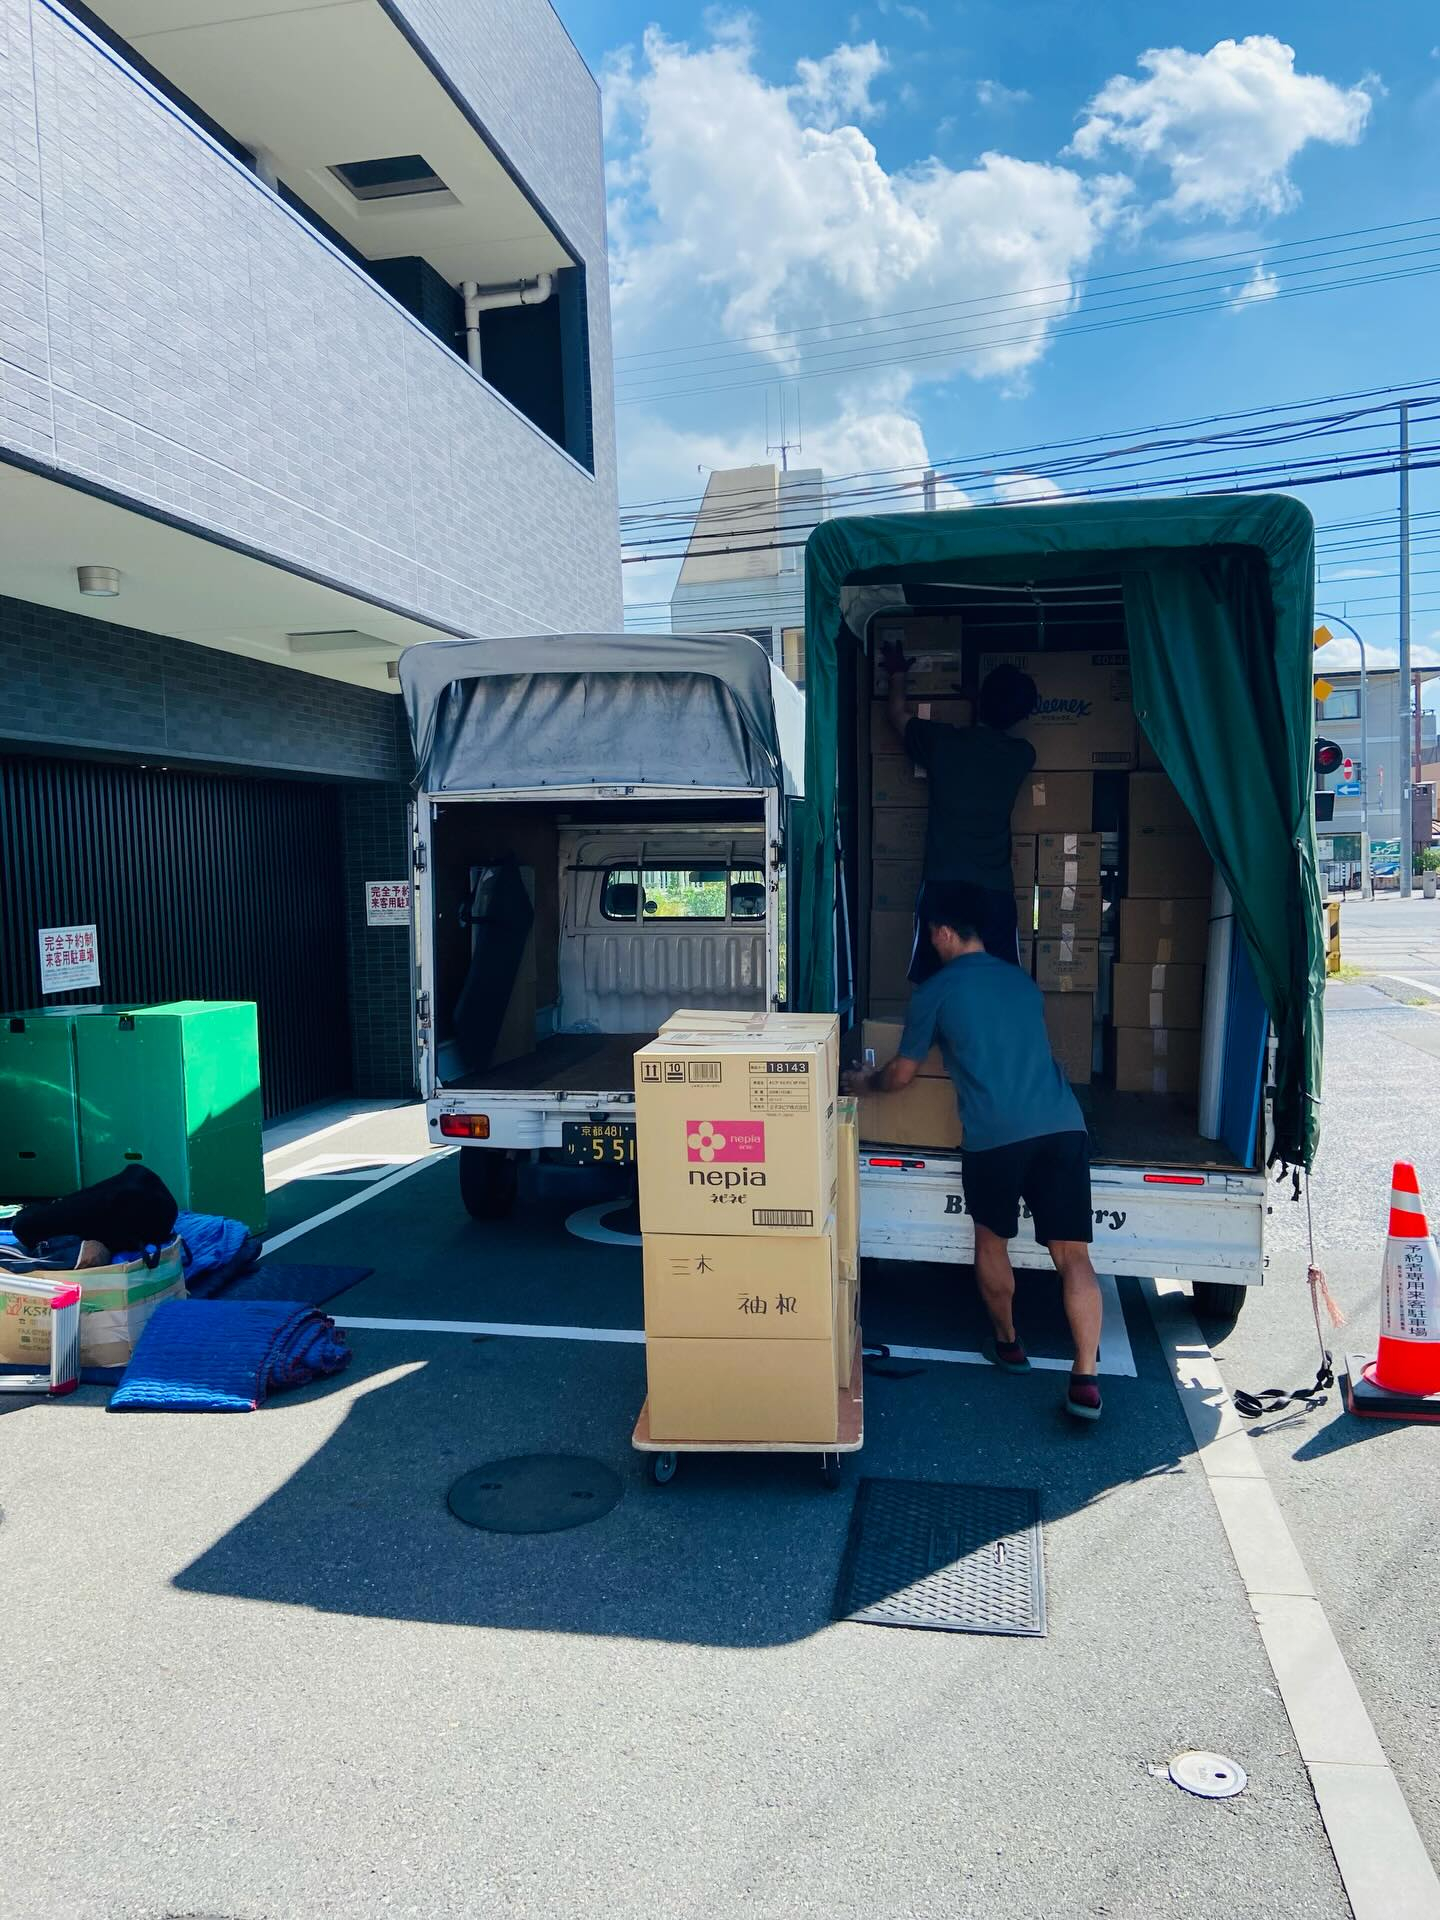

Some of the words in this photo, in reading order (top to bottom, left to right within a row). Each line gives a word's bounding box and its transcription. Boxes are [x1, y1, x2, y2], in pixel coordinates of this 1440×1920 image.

[44, 932, 94, 952] 完全予約制
[45, 947, 95, 968] 来客用駐車場
[669, 1063, 681, 1072] 10
[769, 1063, 806, 1072] 18143
[730, 1134, 761, 1145] nepia
[689, 1167, 767, 1189] nepia
[1404, 1244, 1428, 1337] 予約者専用来客駐車場
